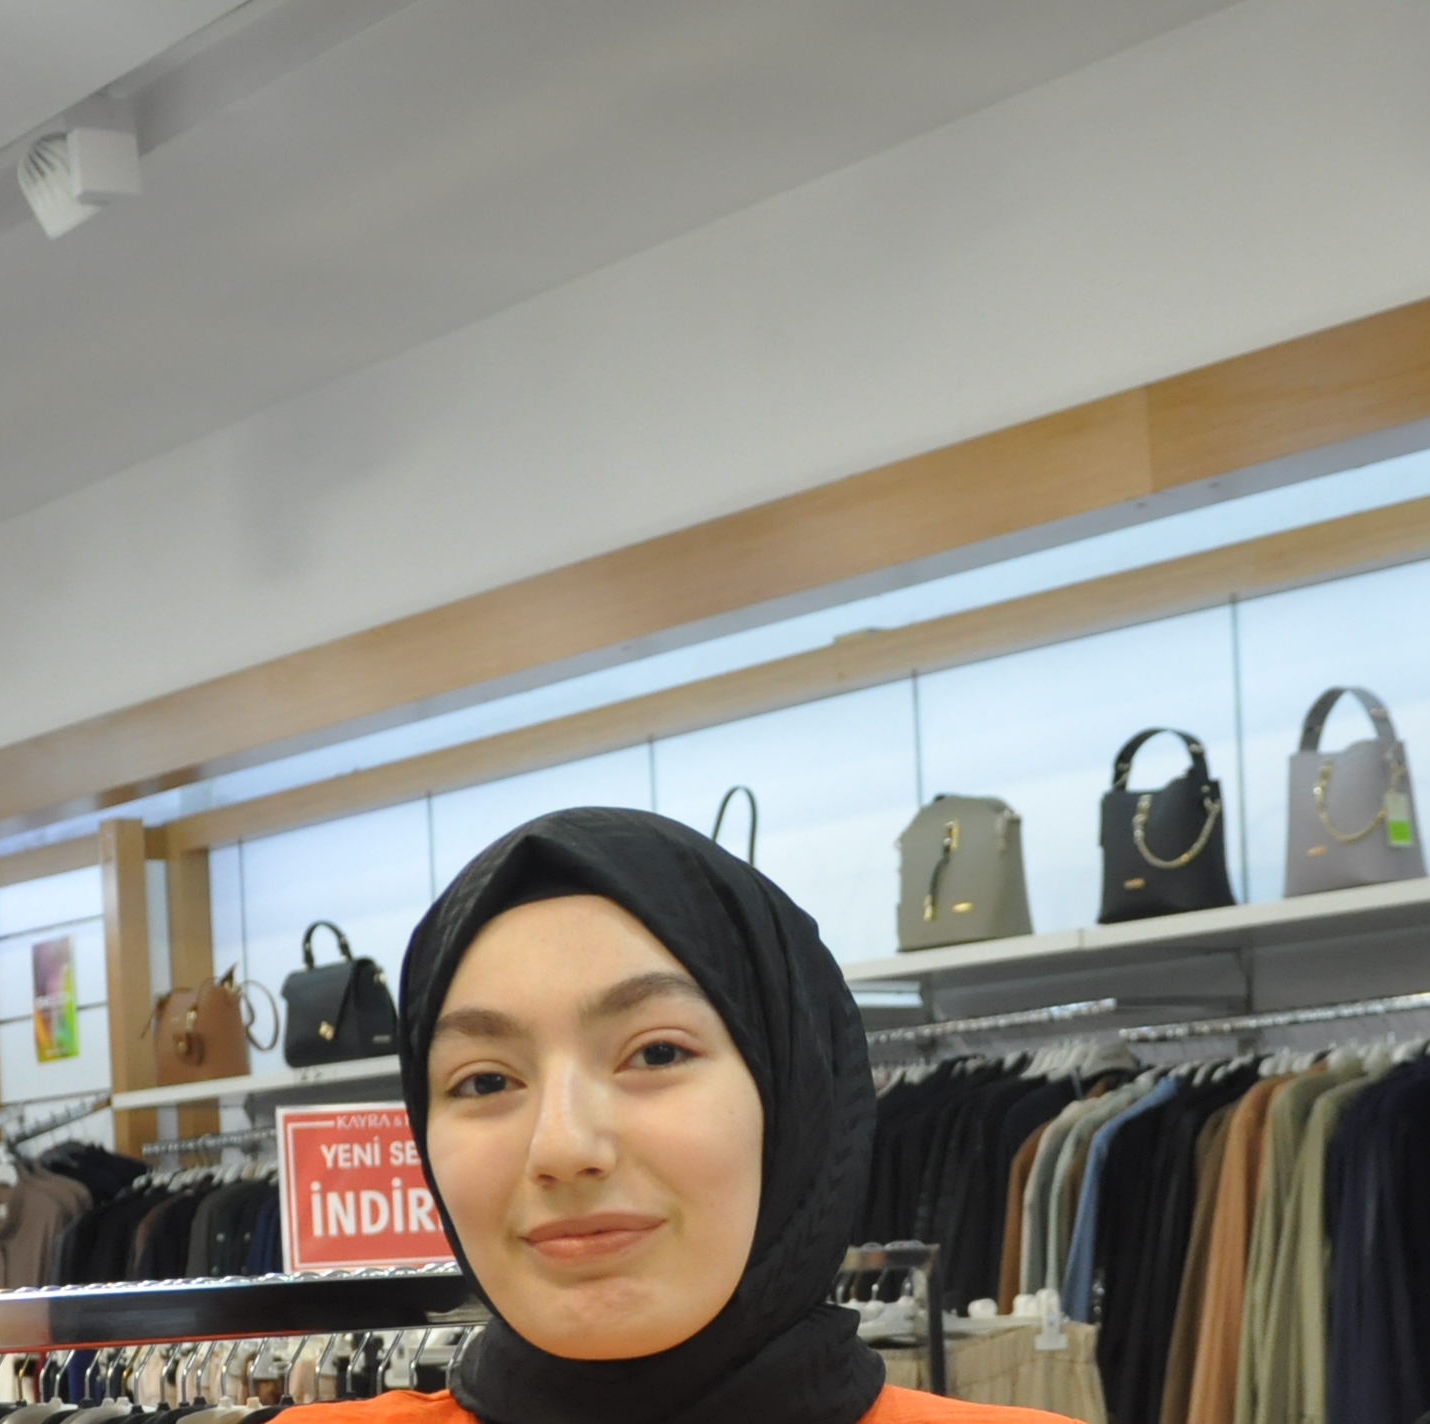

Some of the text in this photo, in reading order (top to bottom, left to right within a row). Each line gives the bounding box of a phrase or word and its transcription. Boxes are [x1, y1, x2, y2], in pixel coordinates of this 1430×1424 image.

[321, 1135, 422, 1169] YENİ SE
[310, 1176, 445, 1238] İNDİR
